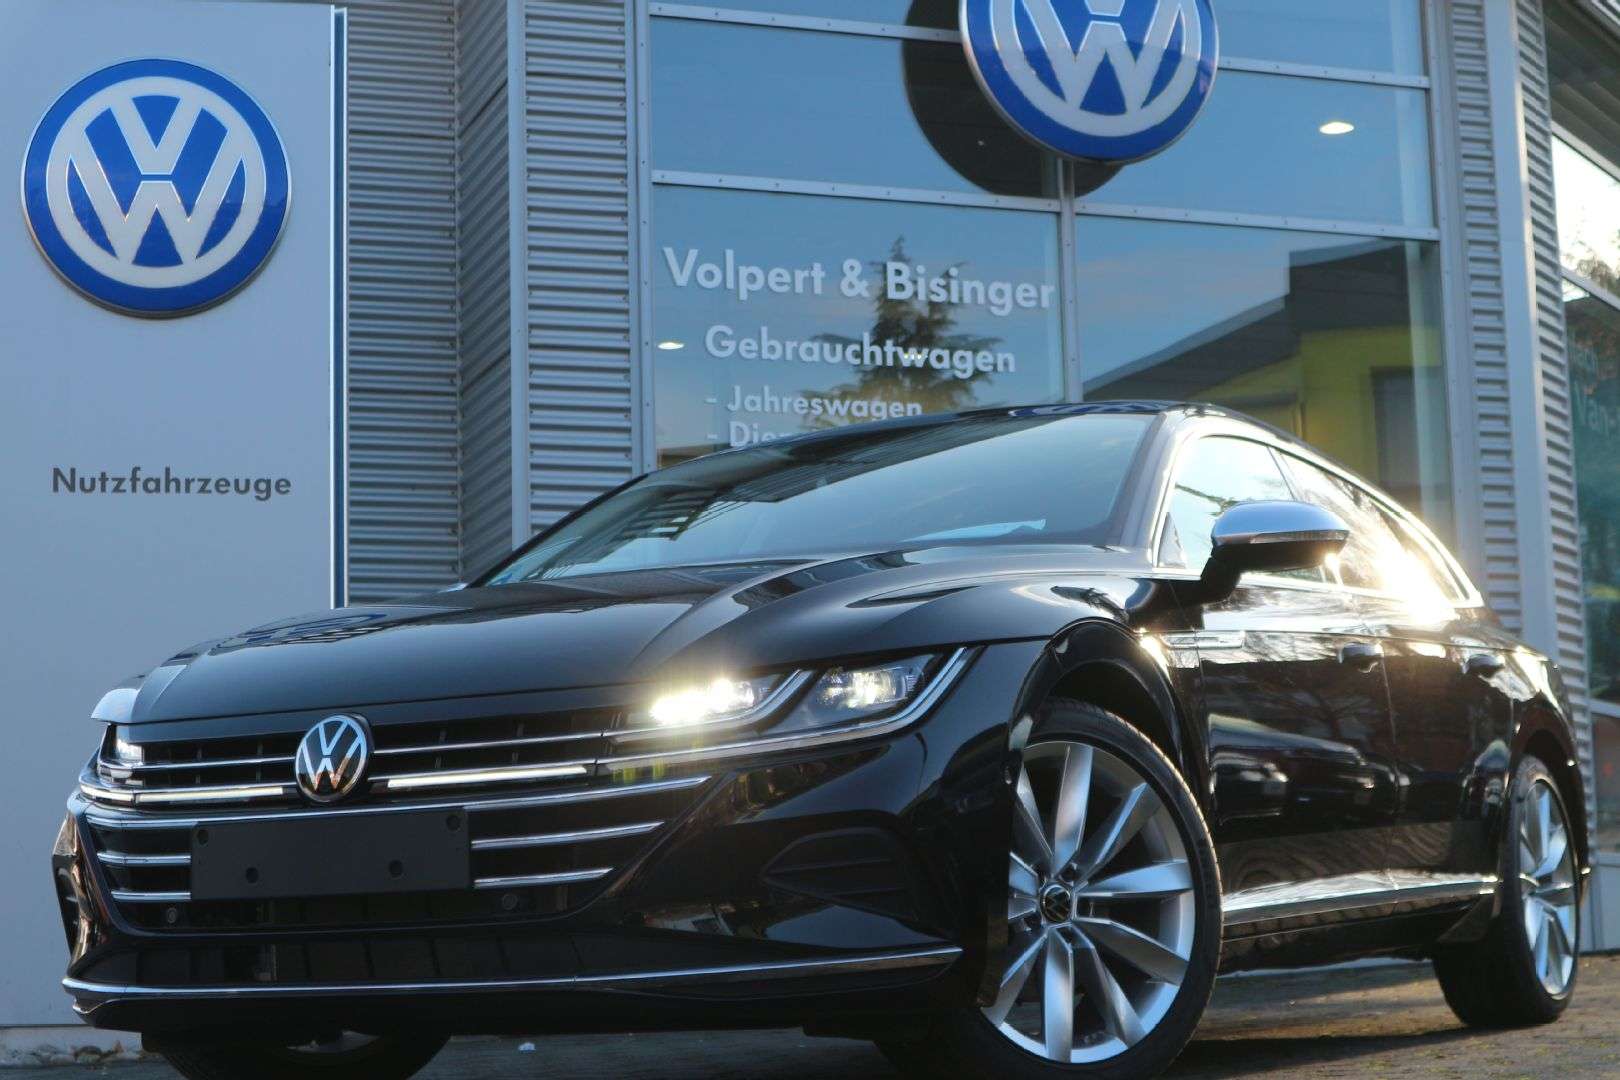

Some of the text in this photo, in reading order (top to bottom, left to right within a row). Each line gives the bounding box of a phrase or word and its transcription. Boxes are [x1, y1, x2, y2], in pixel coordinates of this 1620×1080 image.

[663, 247, 1056, 317] Volpert & Bisinger
[704, 325, 1016, 380] Gebrauchtwagen
[727, 385, 923, 421] Jahreswagen
[729, 421, 791, 447] Die
[52, 466, 292, 502] Nutzfahrzeuge
